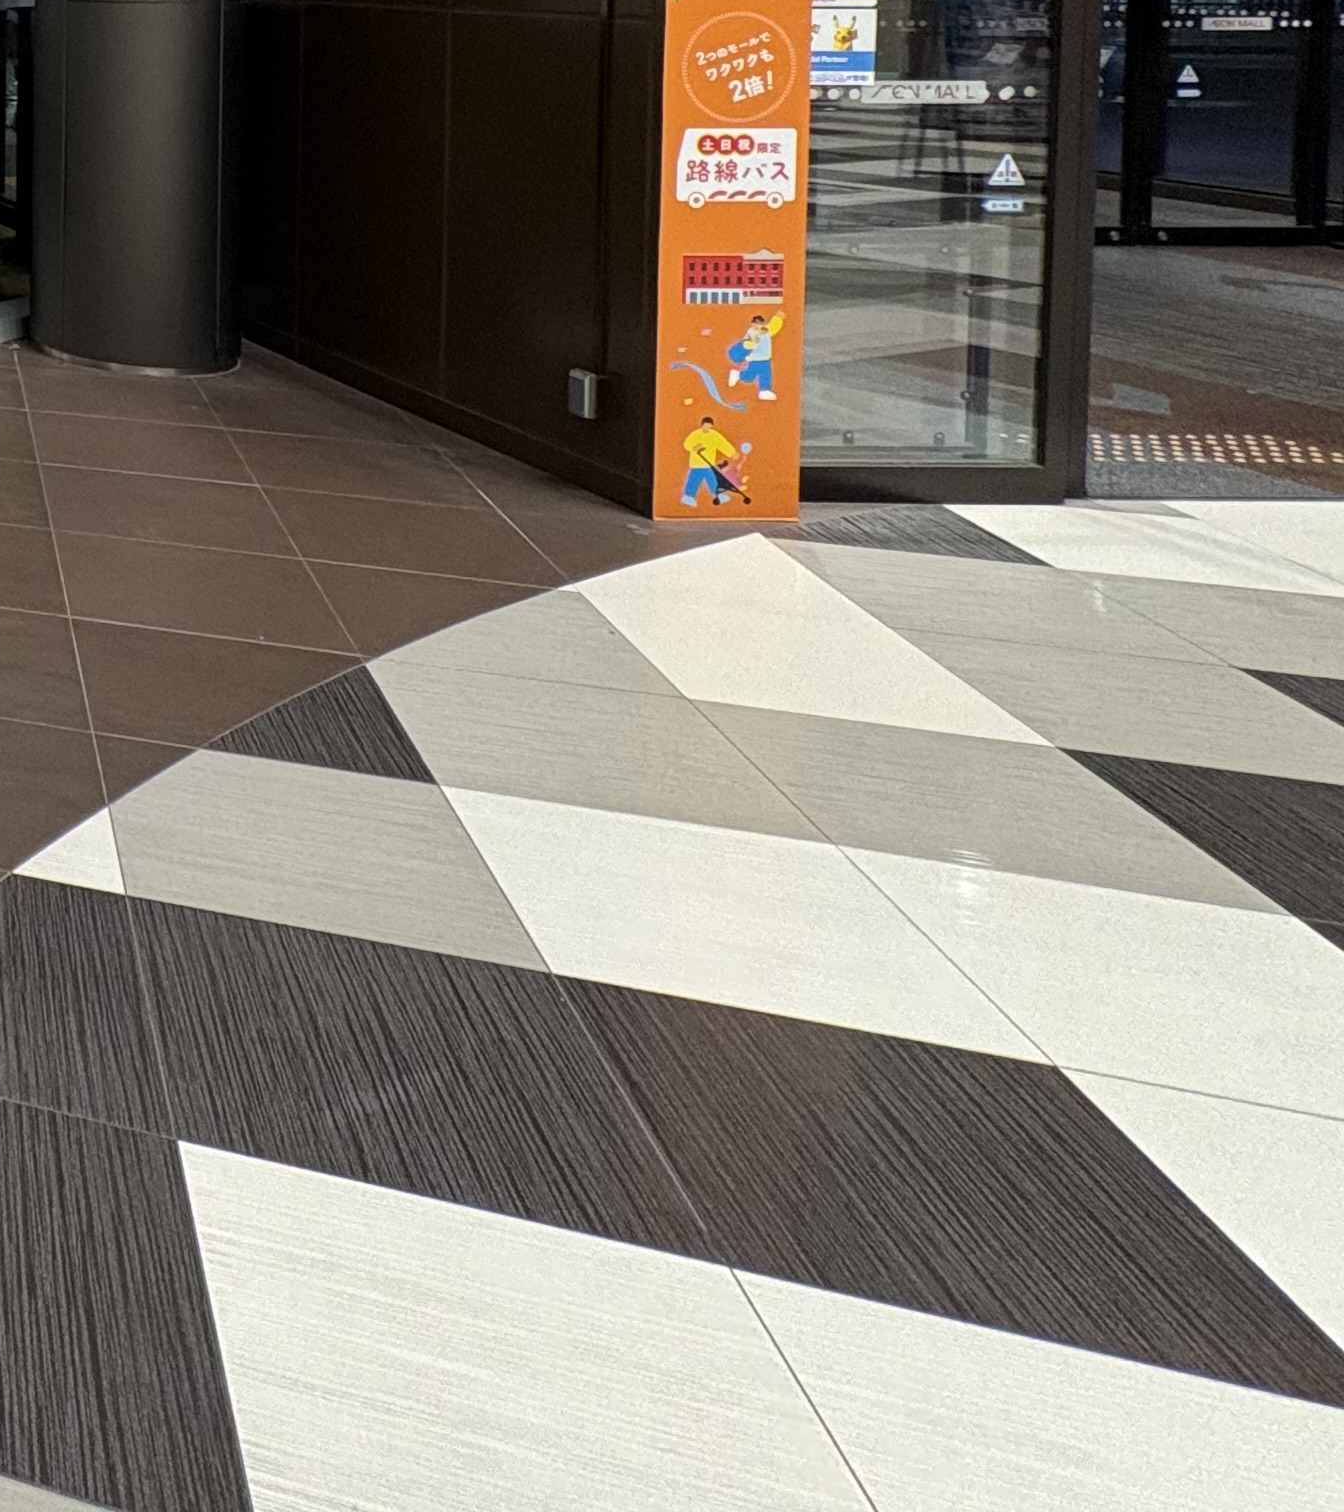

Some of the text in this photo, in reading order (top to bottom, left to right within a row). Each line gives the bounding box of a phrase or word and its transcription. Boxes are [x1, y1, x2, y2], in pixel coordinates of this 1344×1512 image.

[695, 31, 771, 65] 2つのモールで
[705, 49, 774, 81] ワクワクも
[728, 69, 773, 102] 2倍!
[685, 159, 790, 183] 路線バス
